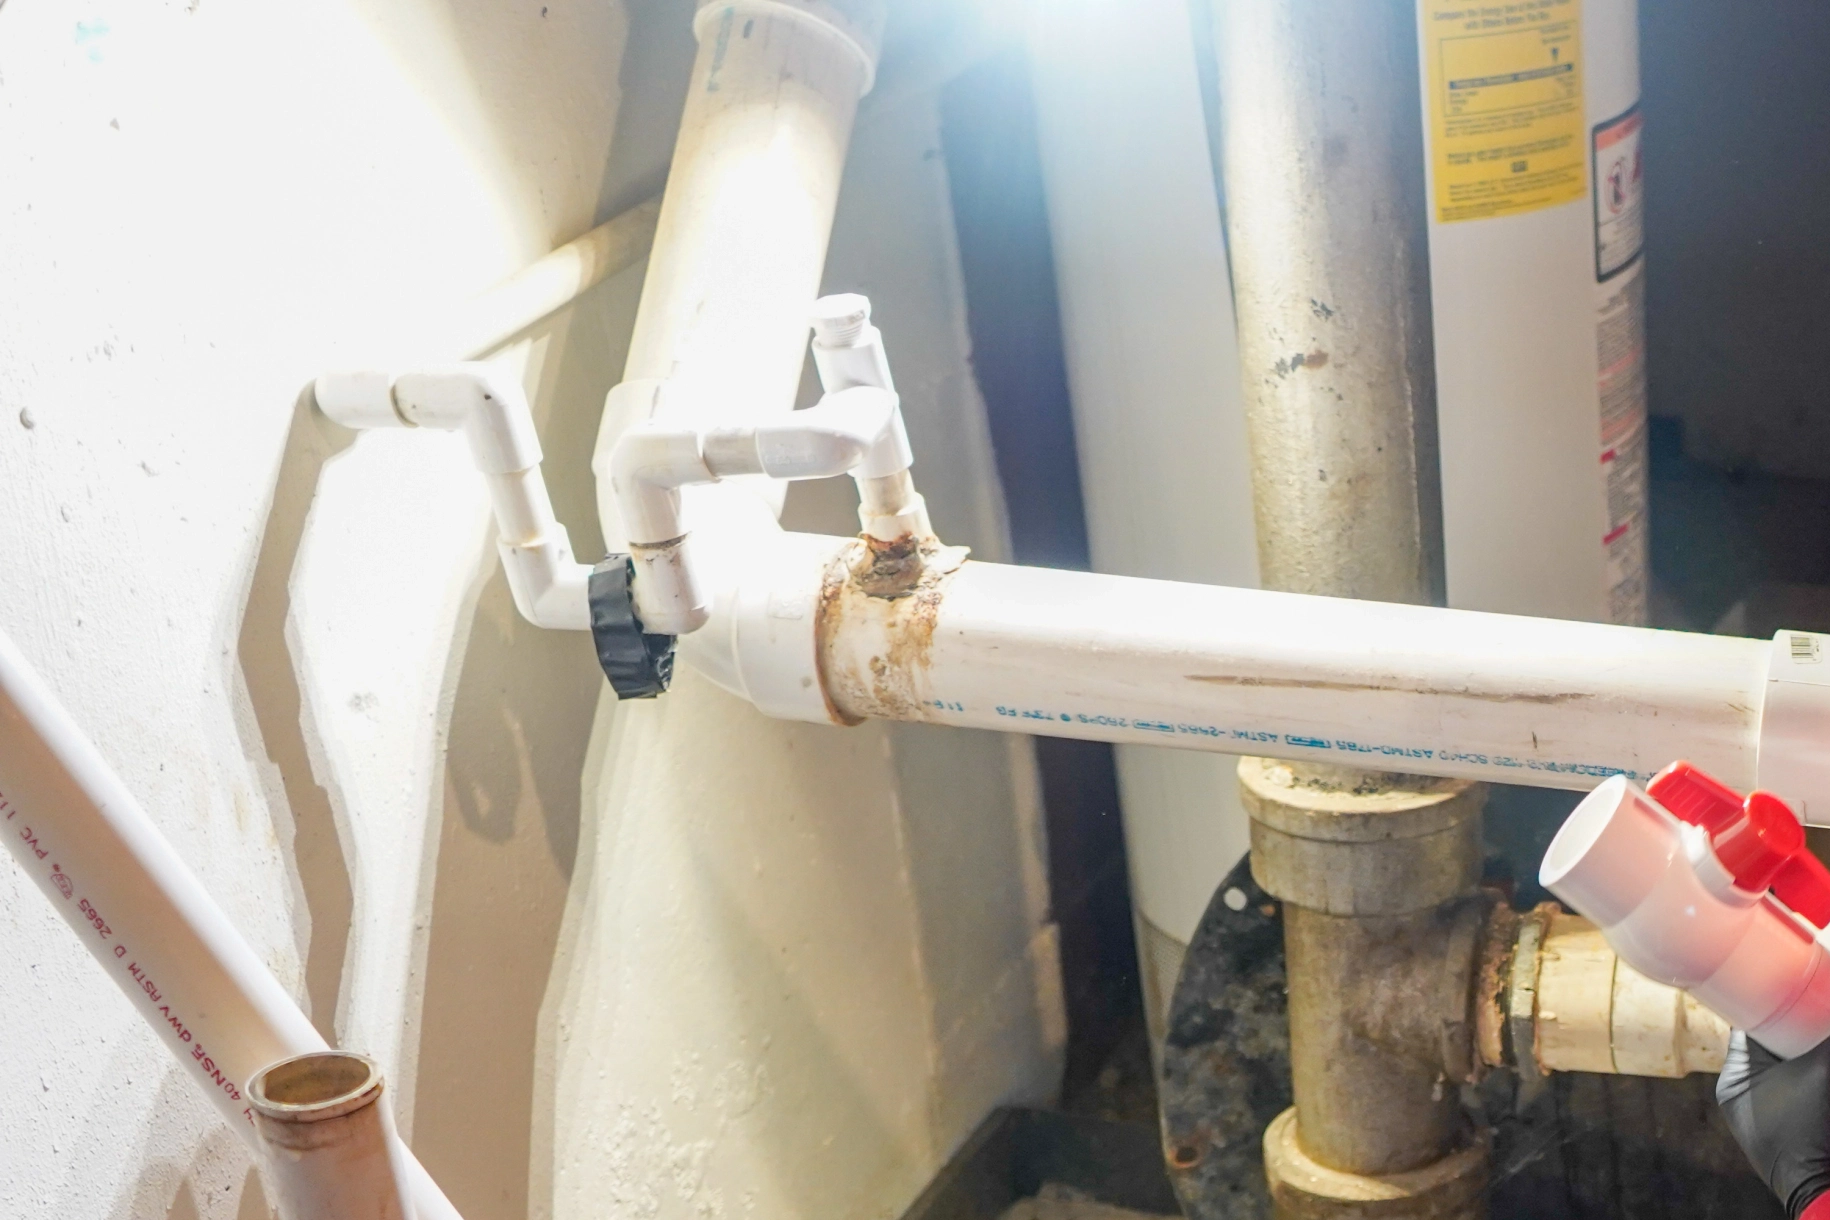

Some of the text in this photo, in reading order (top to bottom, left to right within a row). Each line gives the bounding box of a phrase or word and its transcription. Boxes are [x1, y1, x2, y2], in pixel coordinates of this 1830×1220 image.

[17, 824, 50, 861] PVC
[75, 896, 114, 940] 2665
[111, 941, 128, 959] D
[125, 959, 164, 1003] ASTM
